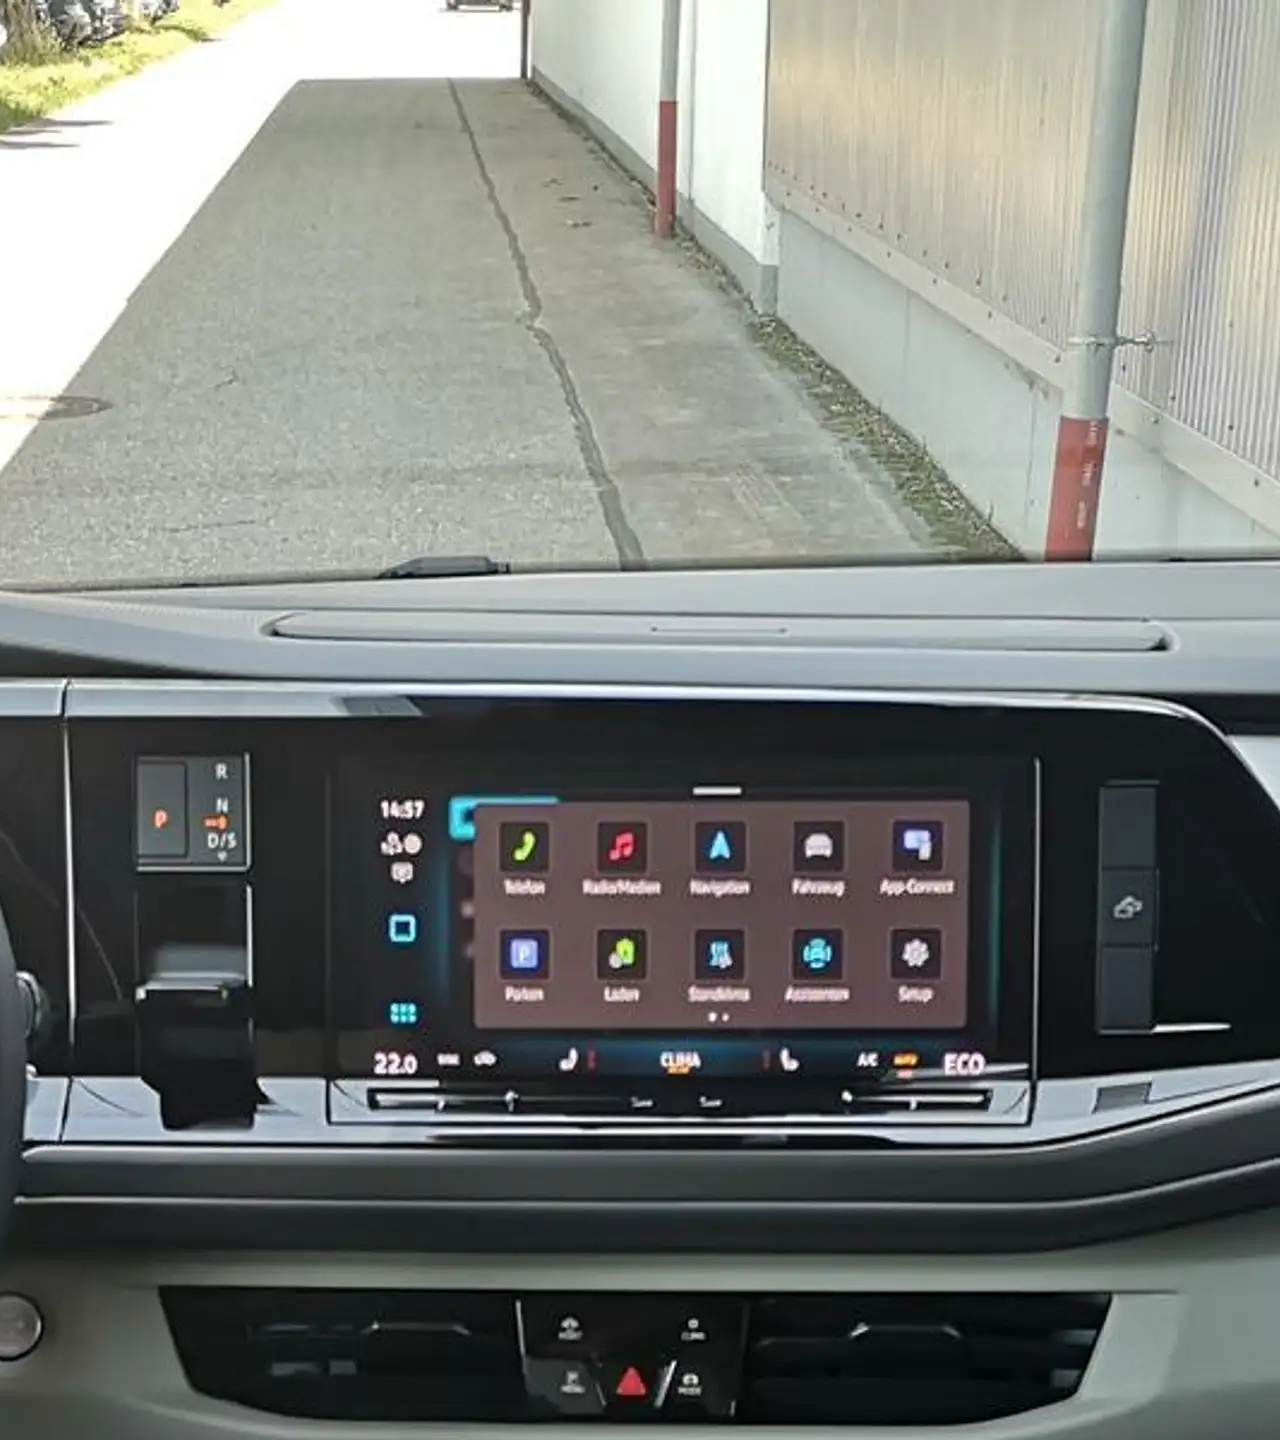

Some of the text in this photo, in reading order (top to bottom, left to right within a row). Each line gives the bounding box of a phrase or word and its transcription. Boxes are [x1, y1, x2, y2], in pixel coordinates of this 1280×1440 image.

[215, 762, 229, 780] R
[380, 800, 425, 819] 14:57
[207, 832, 238, 849] D/S
[504, 879, 546, 895] Telefon
[690, 879, 751, 897] Navigation
[792, 879, 846, 897] Fahrzeug
[505, 985, 545, 1001] Parken
[604, 986, 640, 1002] Laden
[898, 984, 935, 1003] Setup
[373, 1051, 418, 1075] 22.0
[943, 1052, 986, 1076] ECO
